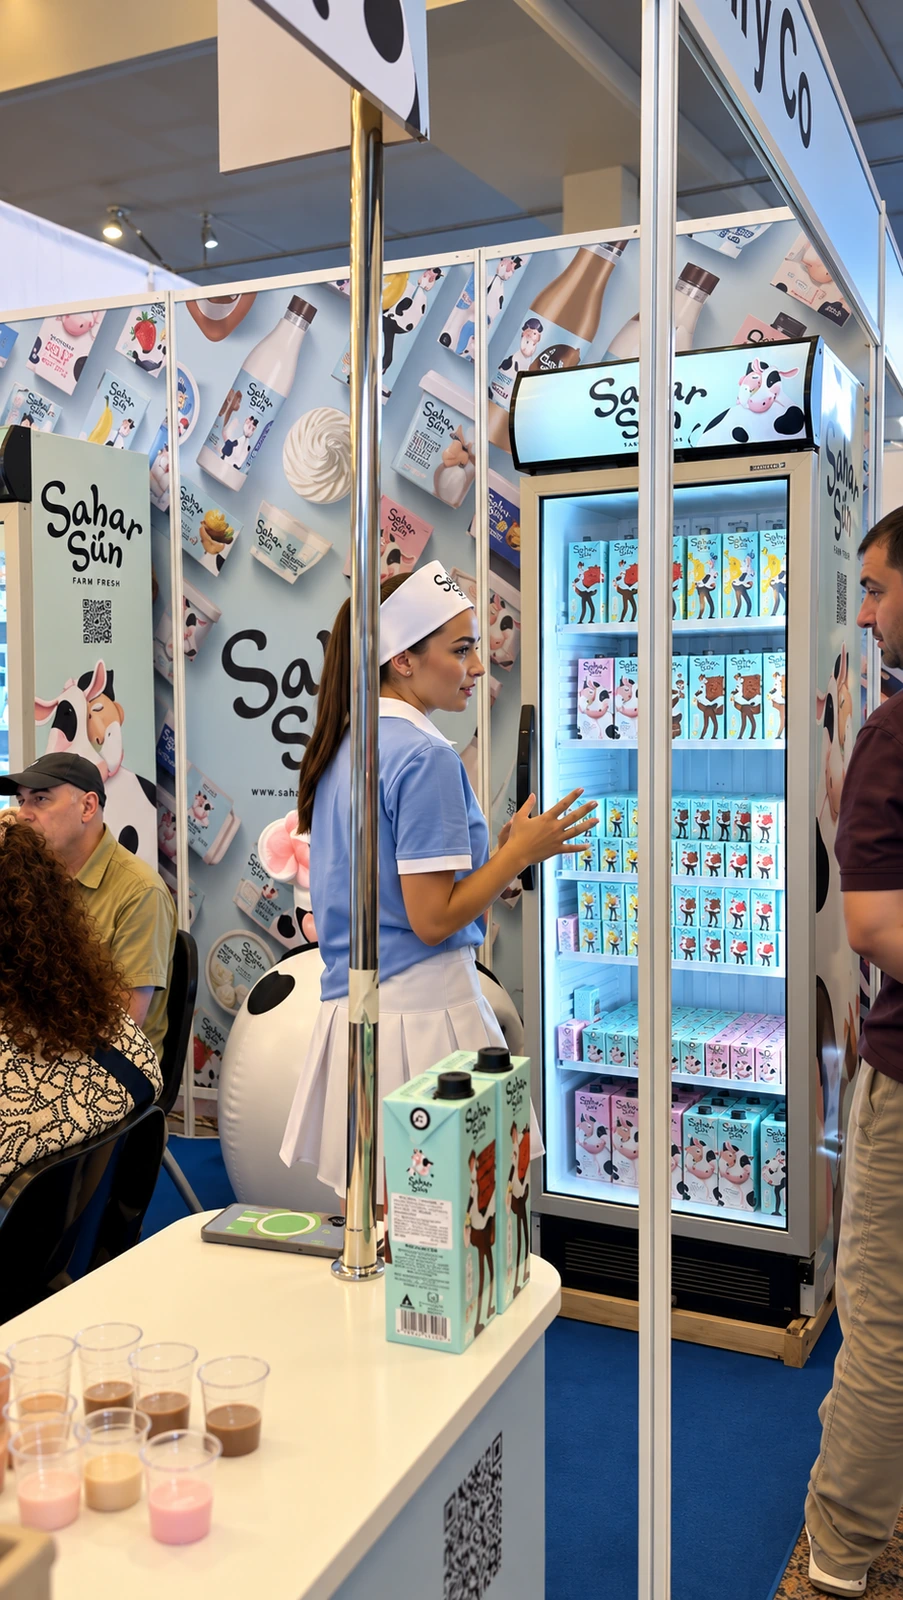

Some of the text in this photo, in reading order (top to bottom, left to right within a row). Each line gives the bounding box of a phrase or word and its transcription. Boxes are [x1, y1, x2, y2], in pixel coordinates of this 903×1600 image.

[780, 8, 811, 149] Co
[423, 401, 454, 431] Sahar
[589, 378, 707, 417] Saar
[826, 421, 859, 502] Sahar
[41, 481, 143, 540] Sahar
[67, 530, 123, 572] Sün
[256, 519, 282, 549] Sahar
[72, 577, 120, 587] FARM FRESH
